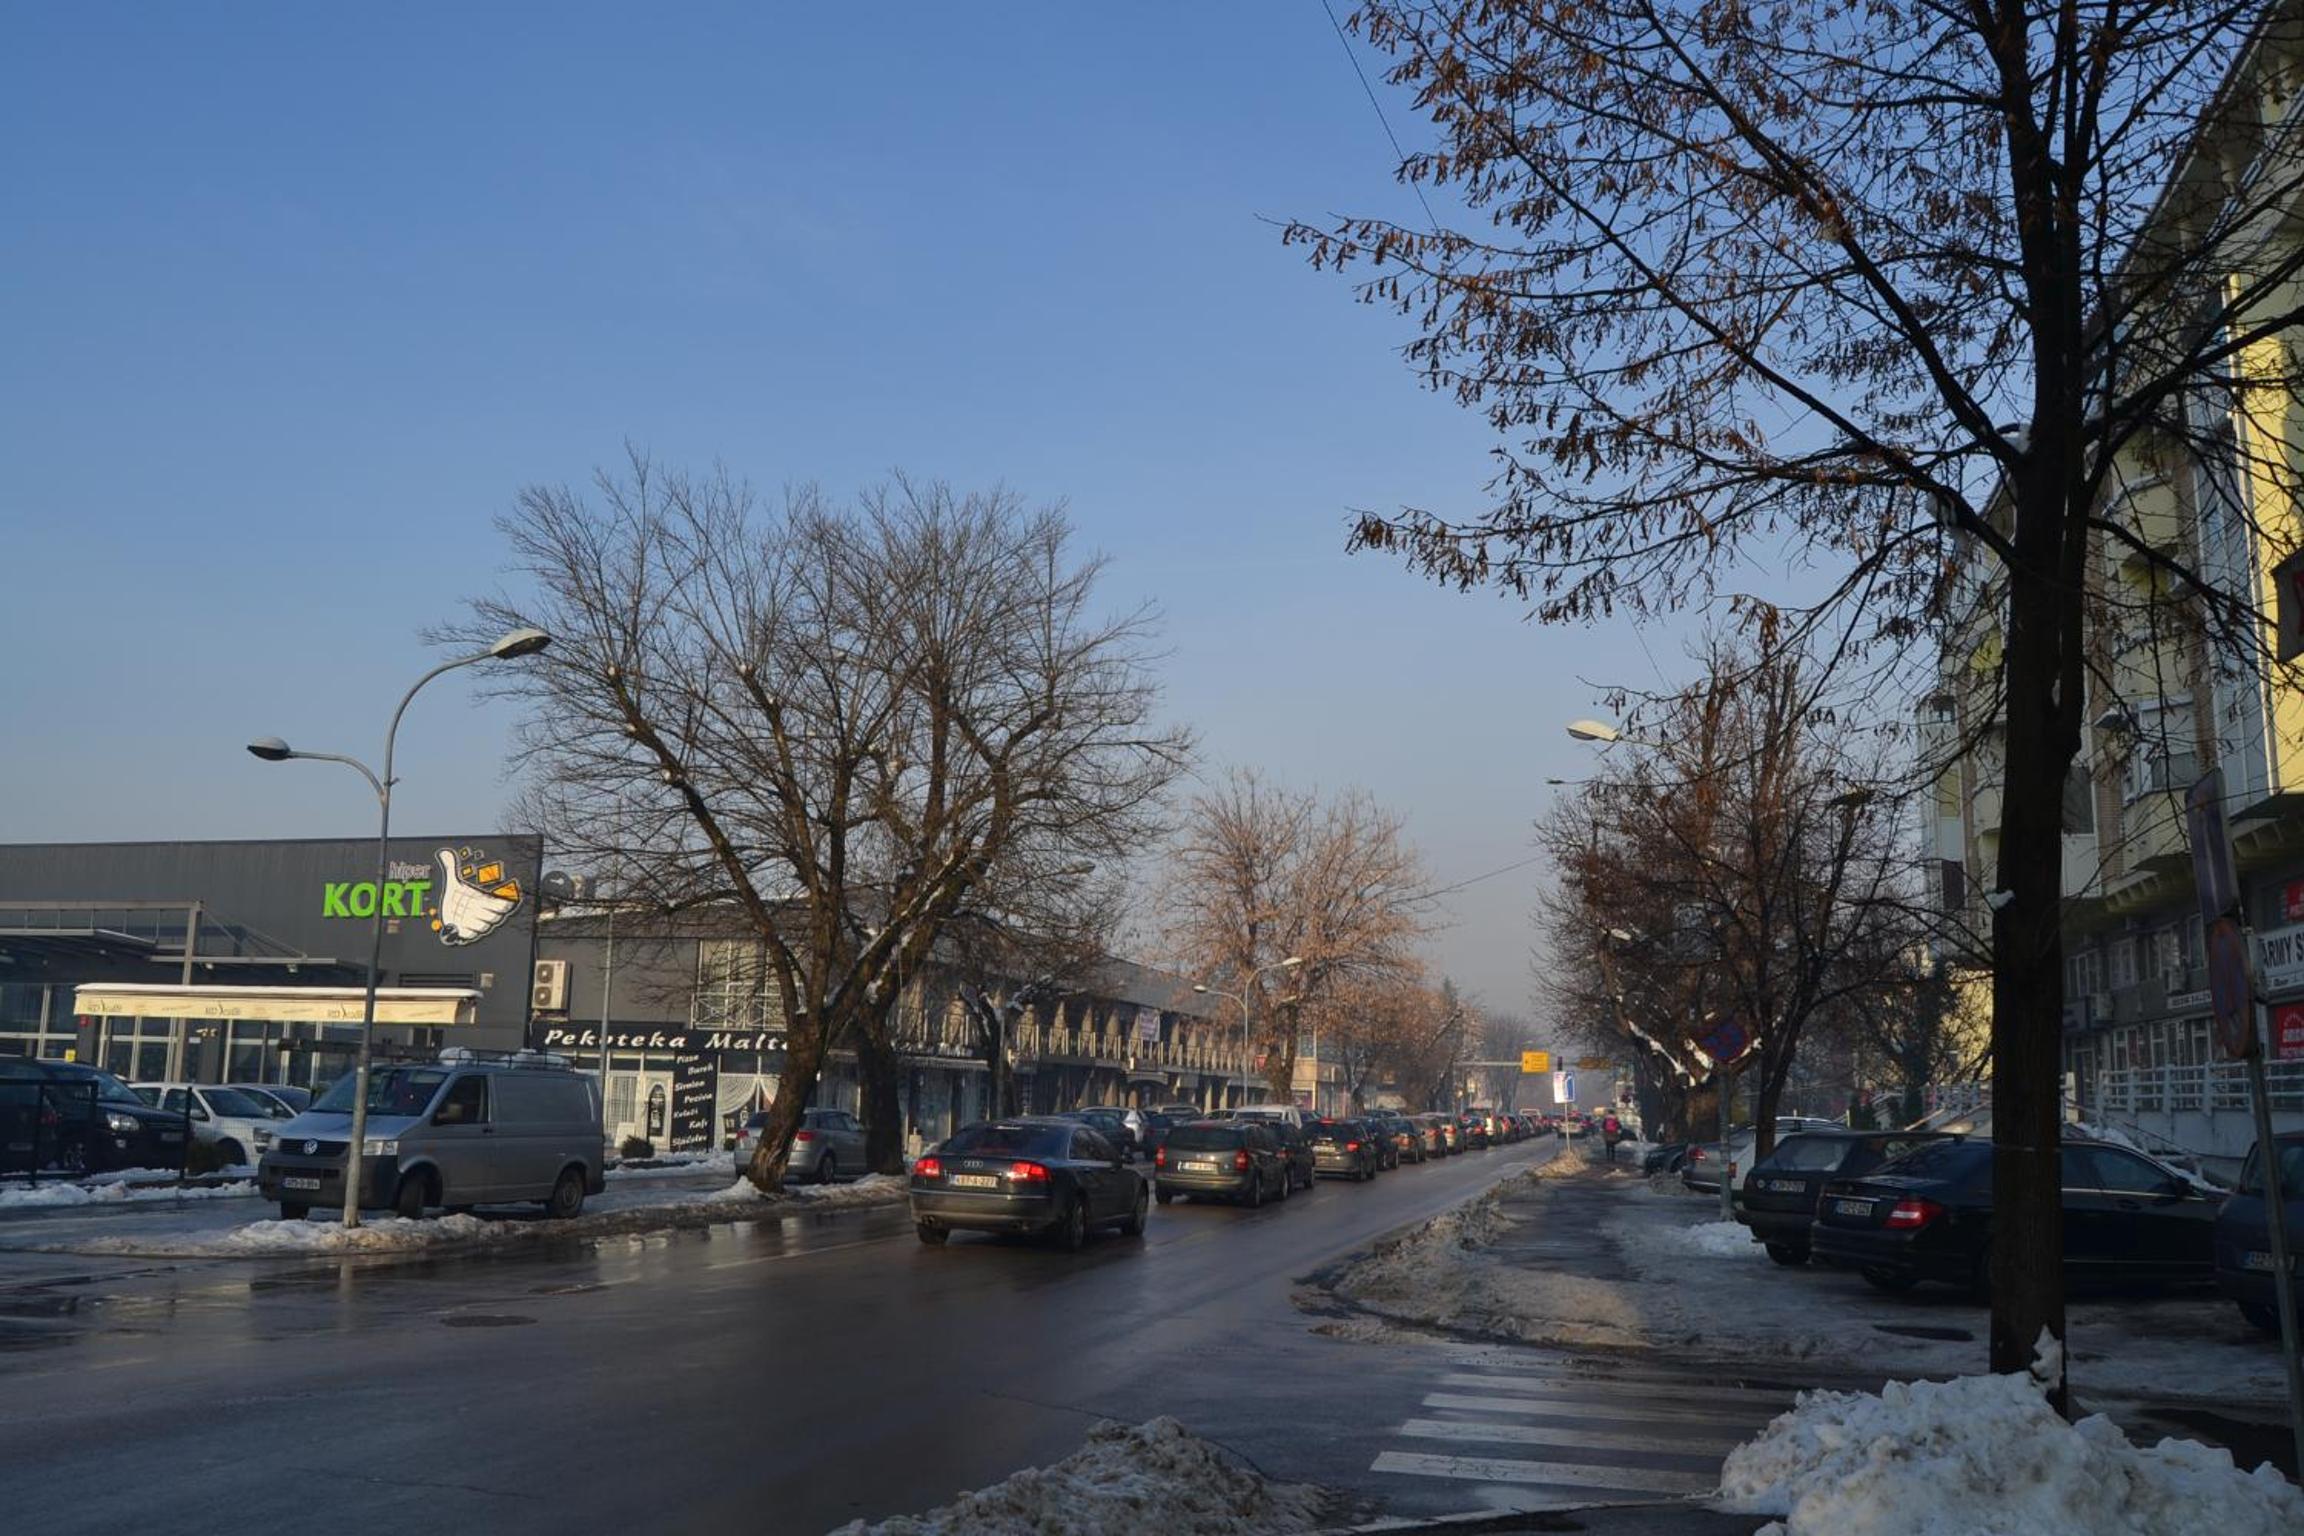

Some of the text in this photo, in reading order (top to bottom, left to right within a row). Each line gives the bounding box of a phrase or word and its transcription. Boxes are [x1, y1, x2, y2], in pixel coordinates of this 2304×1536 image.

[389, 860, 431, 884] hiper
[323, 882, 432, 917] KORT
[2263, 936, 2292, 968] ARMY
